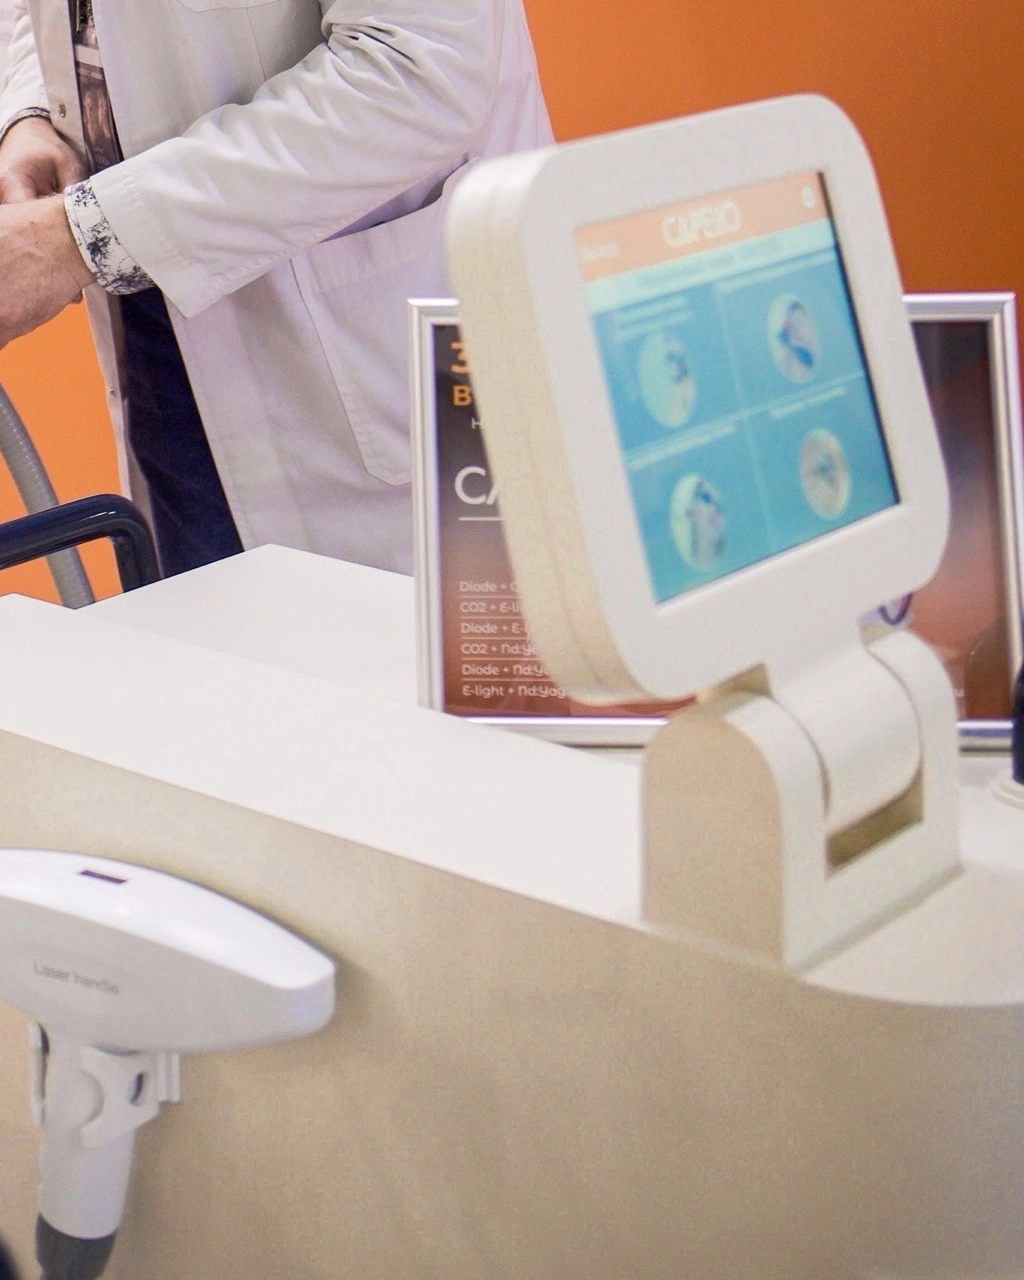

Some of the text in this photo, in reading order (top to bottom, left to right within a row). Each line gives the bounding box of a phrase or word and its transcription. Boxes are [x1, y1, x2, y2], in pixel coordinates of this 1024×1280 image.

[459, 581, 497, 593] Diode
[459, 601, 487, 613] CO2
[460, 622, 498, 634] Diode
[460, 643, 488, 655] CO2
[462, 664, 500, 676] Diode
[33, 960, 68, 982] Laser
